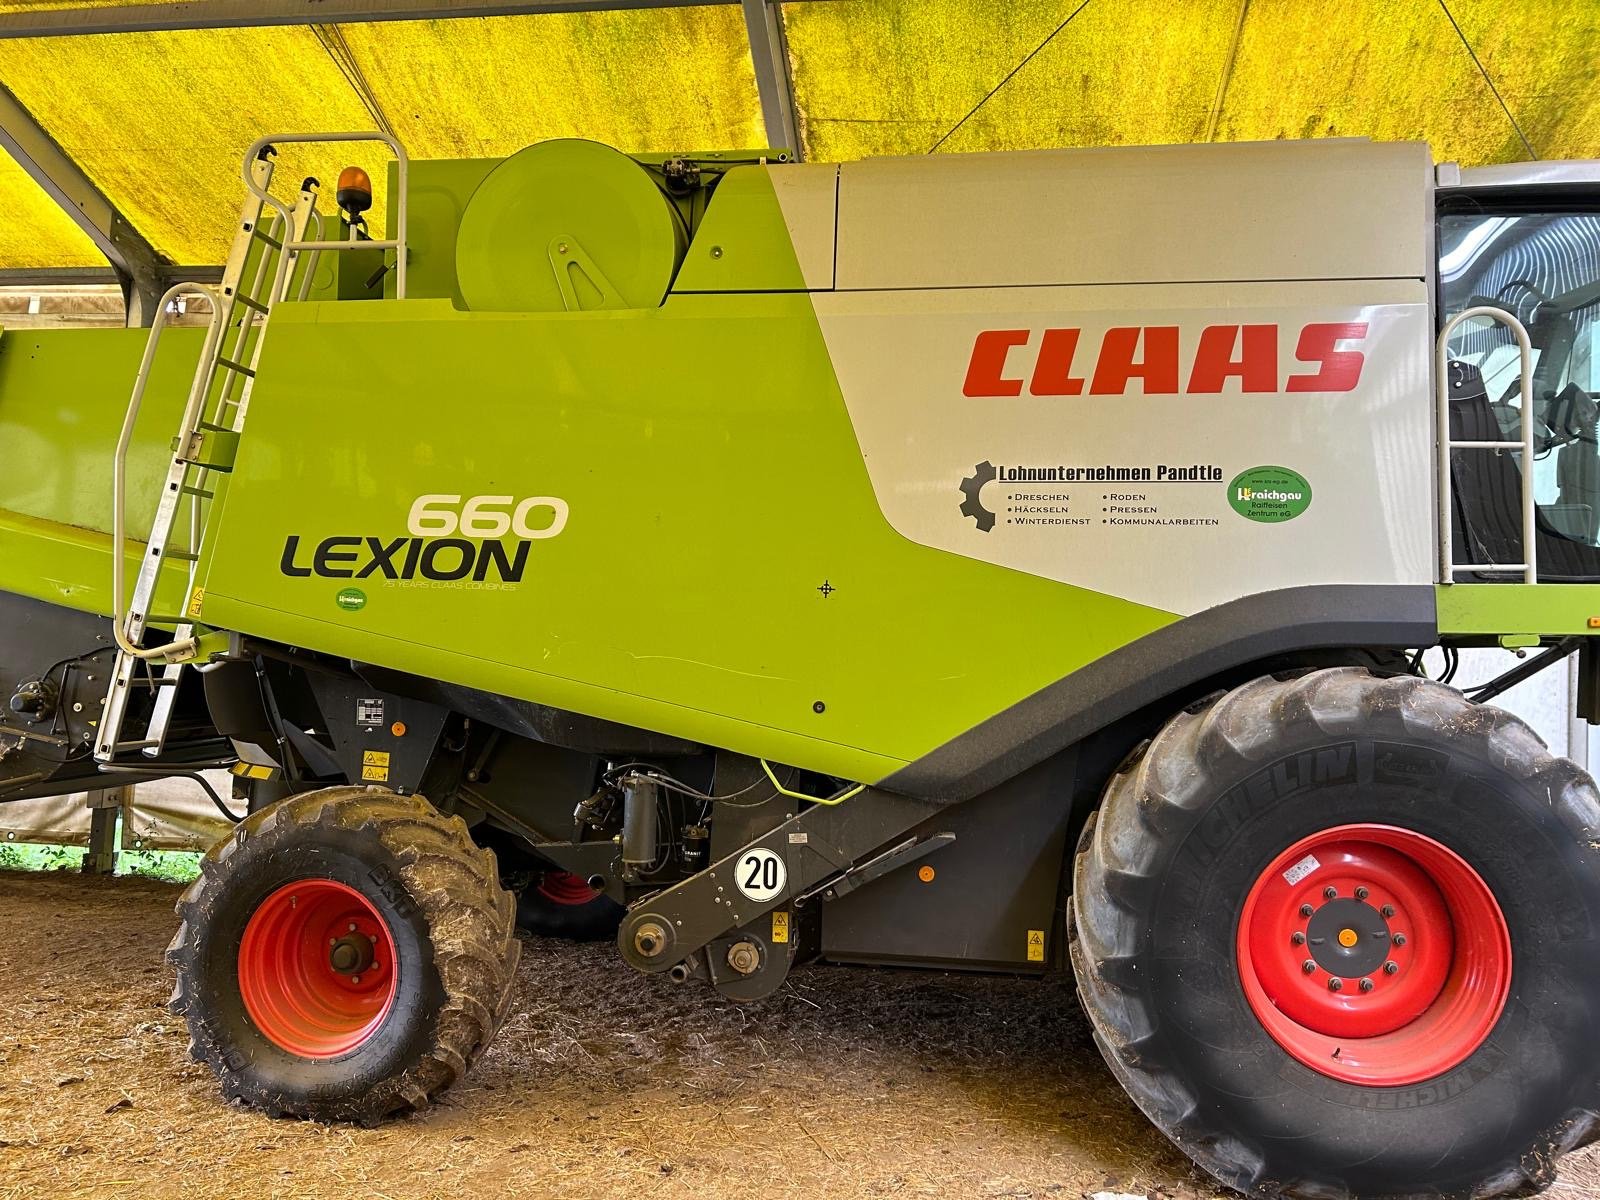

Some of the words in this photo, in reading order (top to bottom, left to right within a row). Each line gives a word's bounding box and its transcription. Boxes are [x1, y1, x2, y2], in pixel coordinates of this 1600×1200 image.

[962, 322, 1367, 398] CLAAS
[999, 465, 1151, 481] Lohnunternehmen
[1156, 465, 1223, 481] Pandtle
[1014, 493, 1070, 501] DRESCHEN
[1110, 493, 1146, 501] RODEN
[1238, 488, 1302, 502] Kraichgau
[1014, 504, 1069, 513] HÄCKSELN
[1110, 505, 1157, 513] PRESSEN
[407, 494, 569, 539] 660
[1014, 517, 1091, 525] WINTERDIENST
[1109, 517, 1219, 526] KOMMUNALARBEITEN
[280, 535, 532, 583] LEXION
[431, 582, 463, 590] CLAAS
[465, 583, 517, 591] COMBINES
[745, 856, 778, 890] 20
